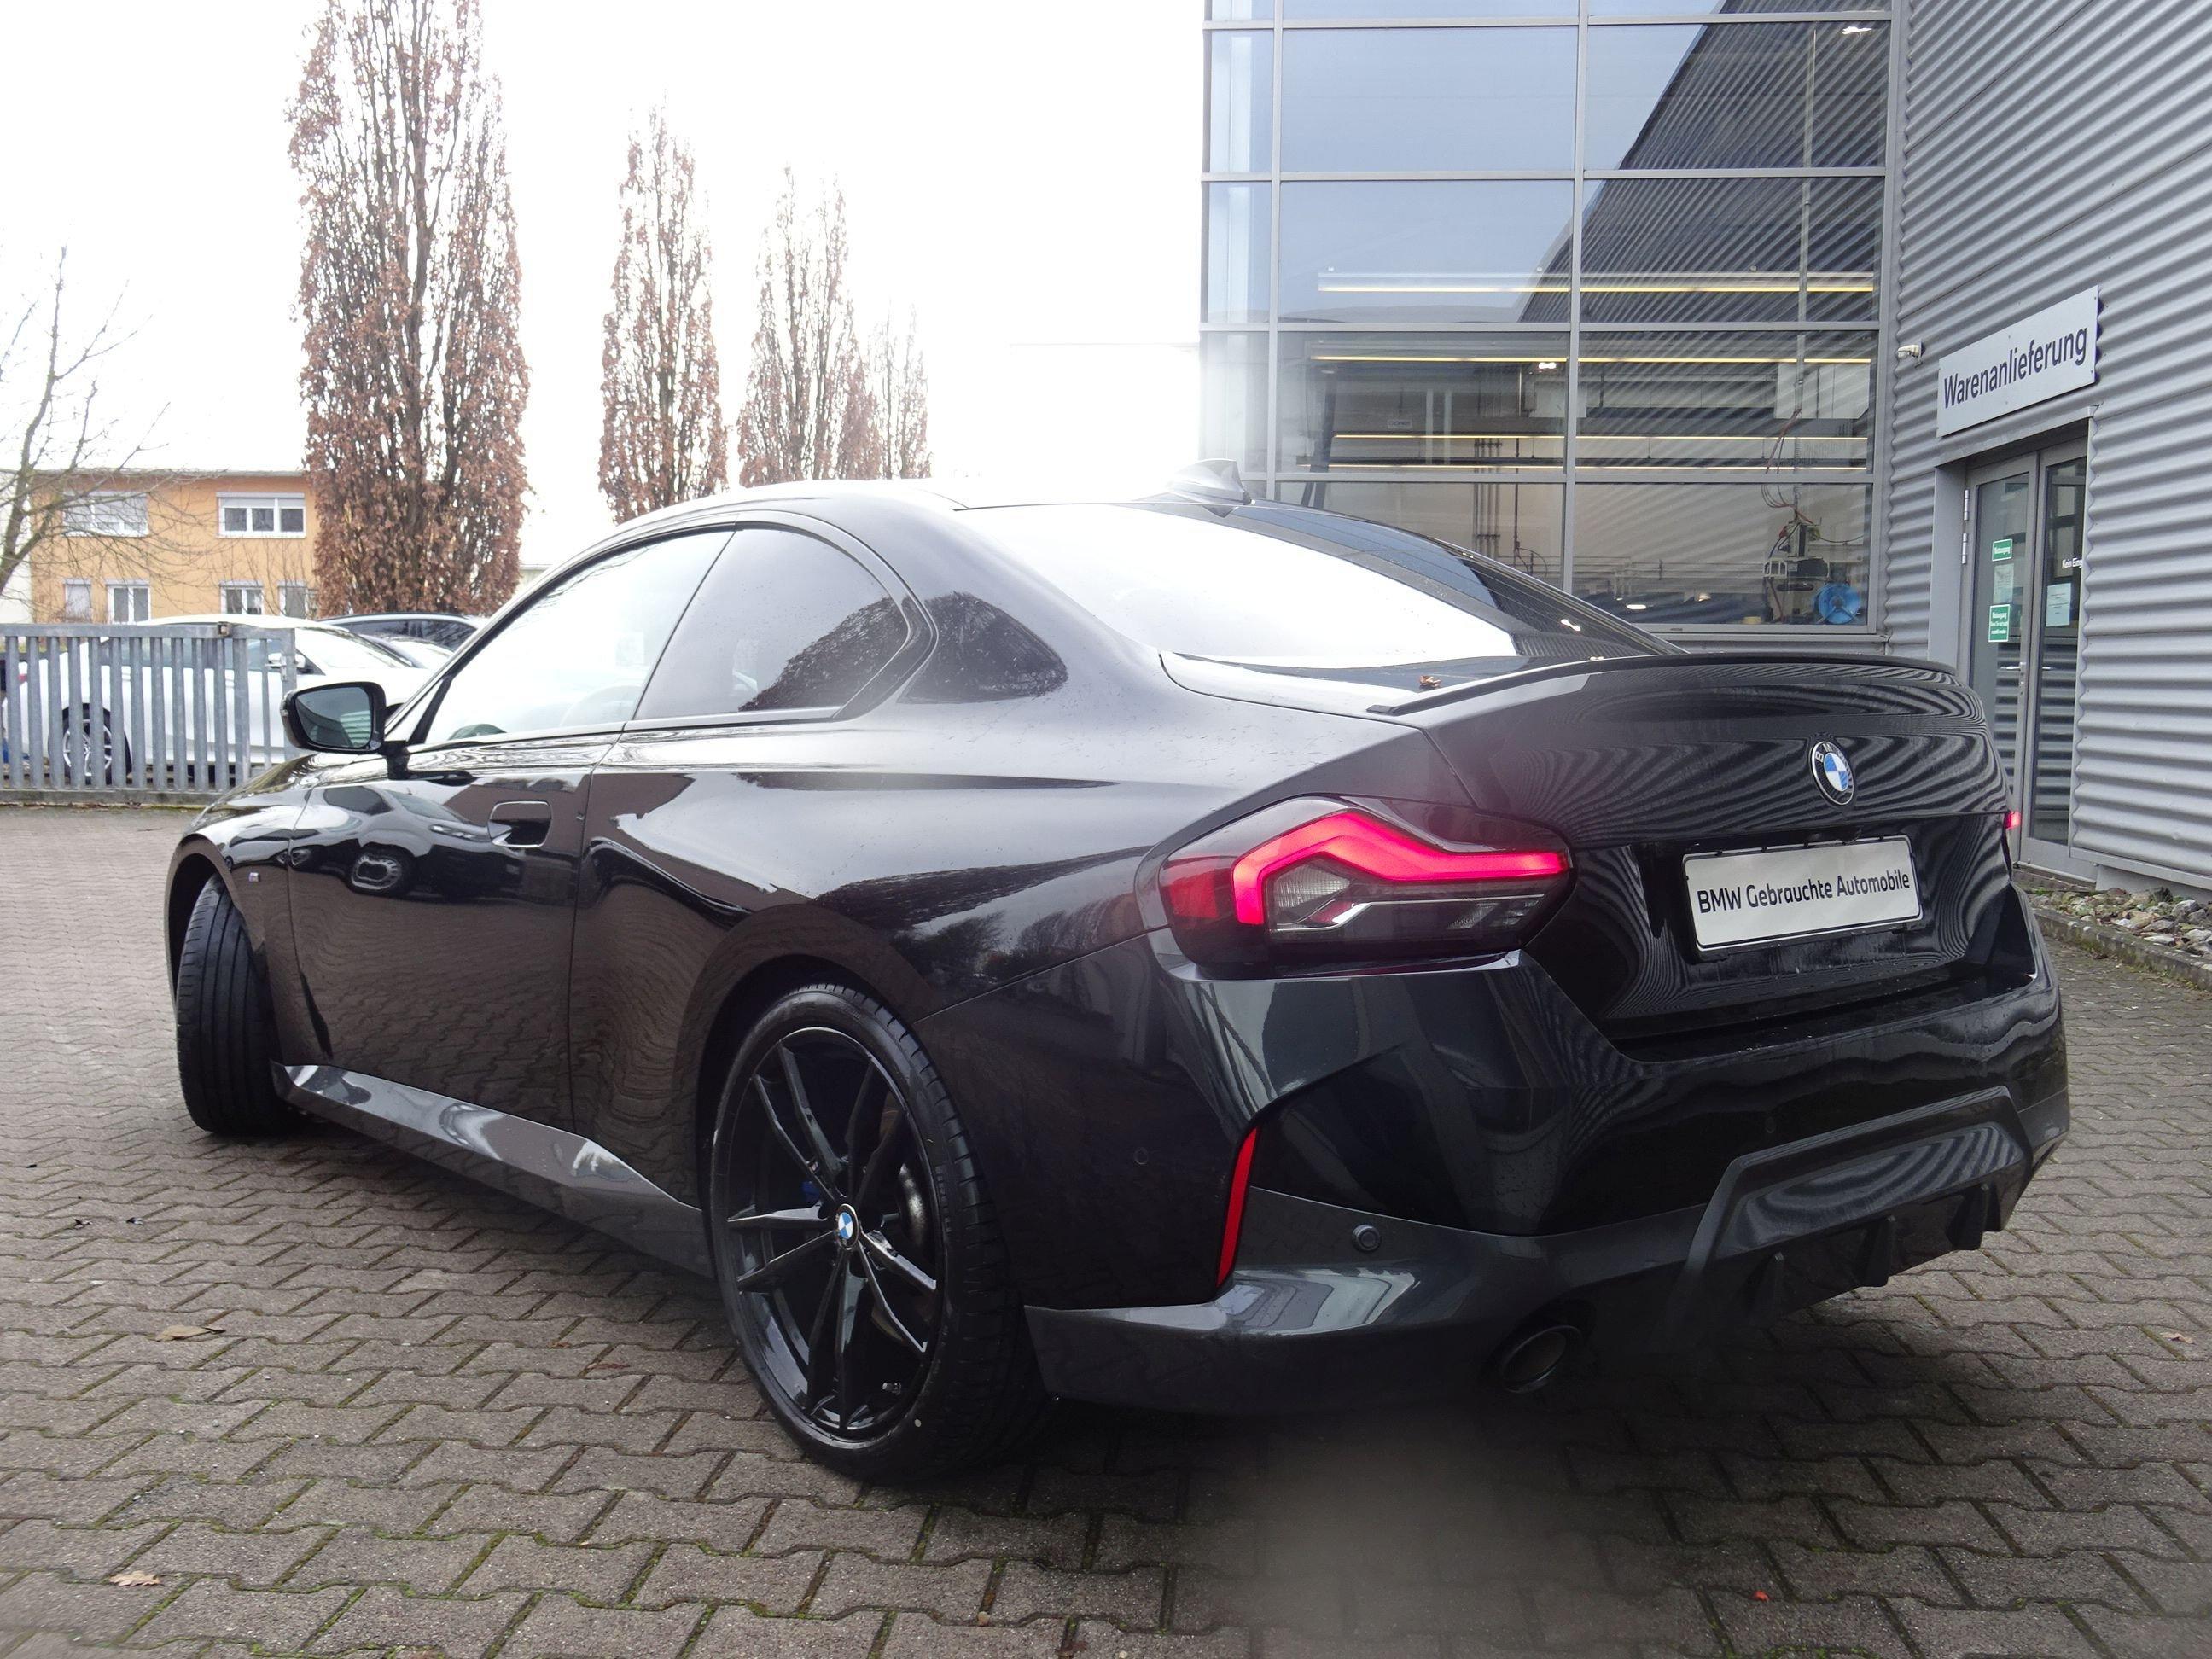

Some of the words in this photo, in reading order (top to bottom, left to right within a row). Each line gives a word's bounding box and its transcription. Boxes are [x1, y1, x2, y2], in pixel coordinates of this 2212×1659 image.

[1944, 328, 2087, 408] Warenanlieferung
[1697, 887, 1742, 913] BMW
[1746, 879, 1833, 908] Gebrauchte
[1837, 869, 1910, 897] Automobile
